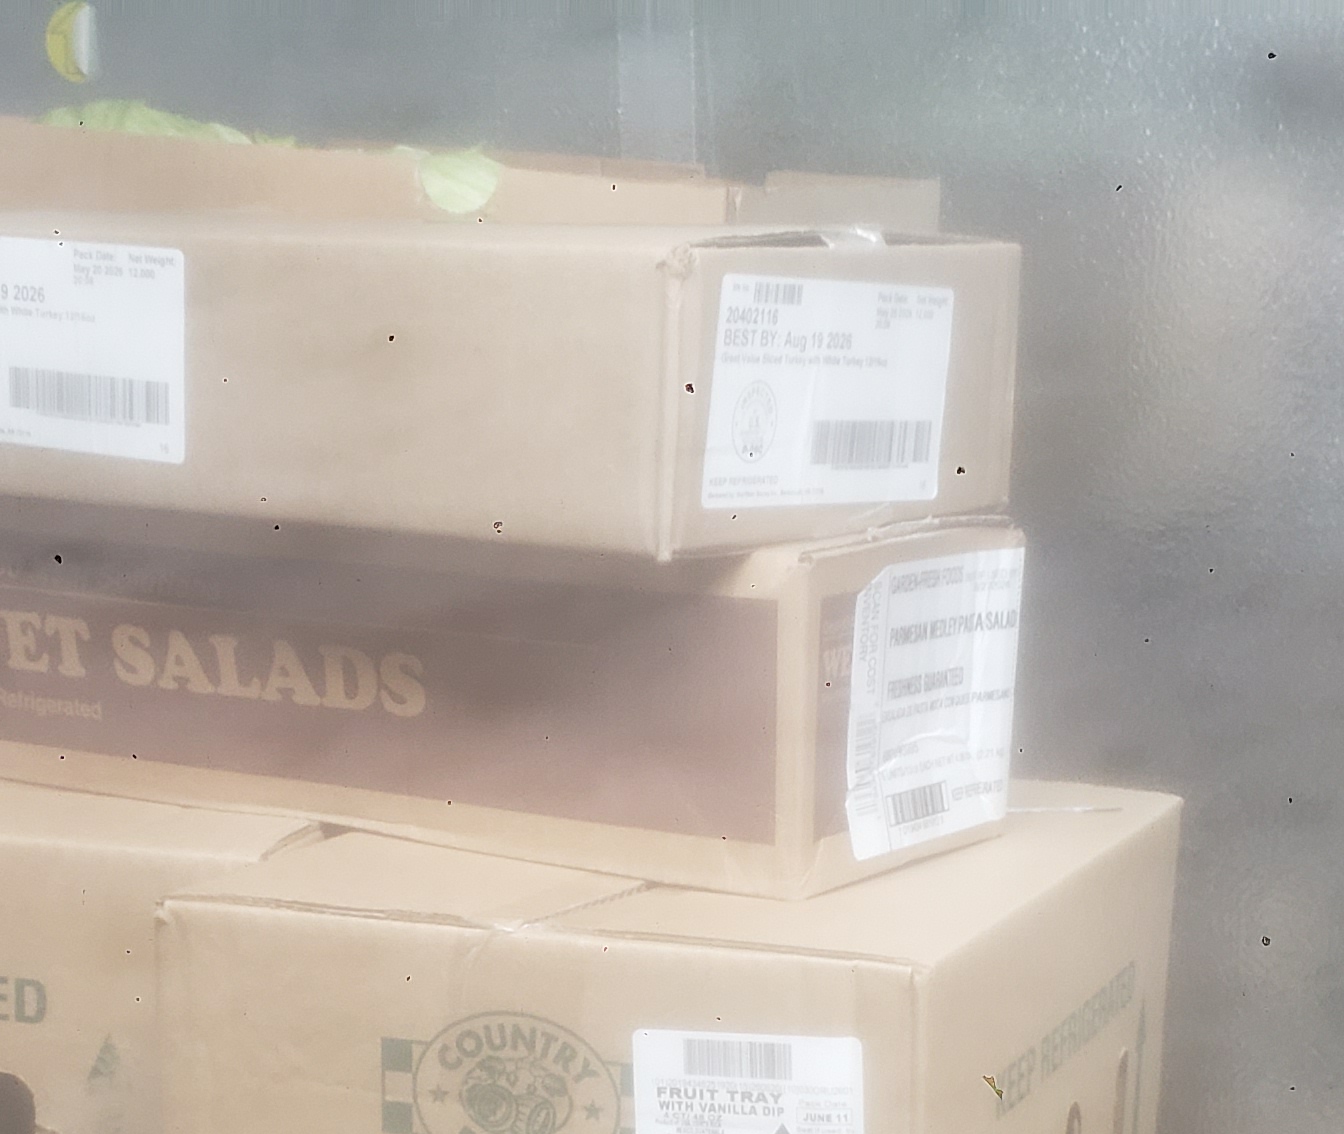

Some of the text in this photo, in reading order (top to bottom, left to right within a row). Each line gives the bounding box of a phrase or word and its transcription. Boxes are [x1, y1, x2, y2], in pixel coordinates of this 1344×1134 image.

[13, 285, 45, 303] 2026
[725, 306, 779, 325] 20402116
[723, 327, 756, 347] BEST
[783, 331, 808, 352] Aug
[811, 331, 824, 349] 19
[826, 332, 852, 350] 2026
[985, 606, 1017, 632] SALAD
[869, 624, 879, 654] FOR
[113, 623, 426, 717] SALADS
[866, 657, 877, 694] COST
[437, 1022, 602, 1087] COUNTRY
[656, 1087, 782, 1104] FRUIT TRAY
[658, 1100, 784, 1117] WITH VANILLA DIP
[803, 1113, 848, 1123] JUNE 11
